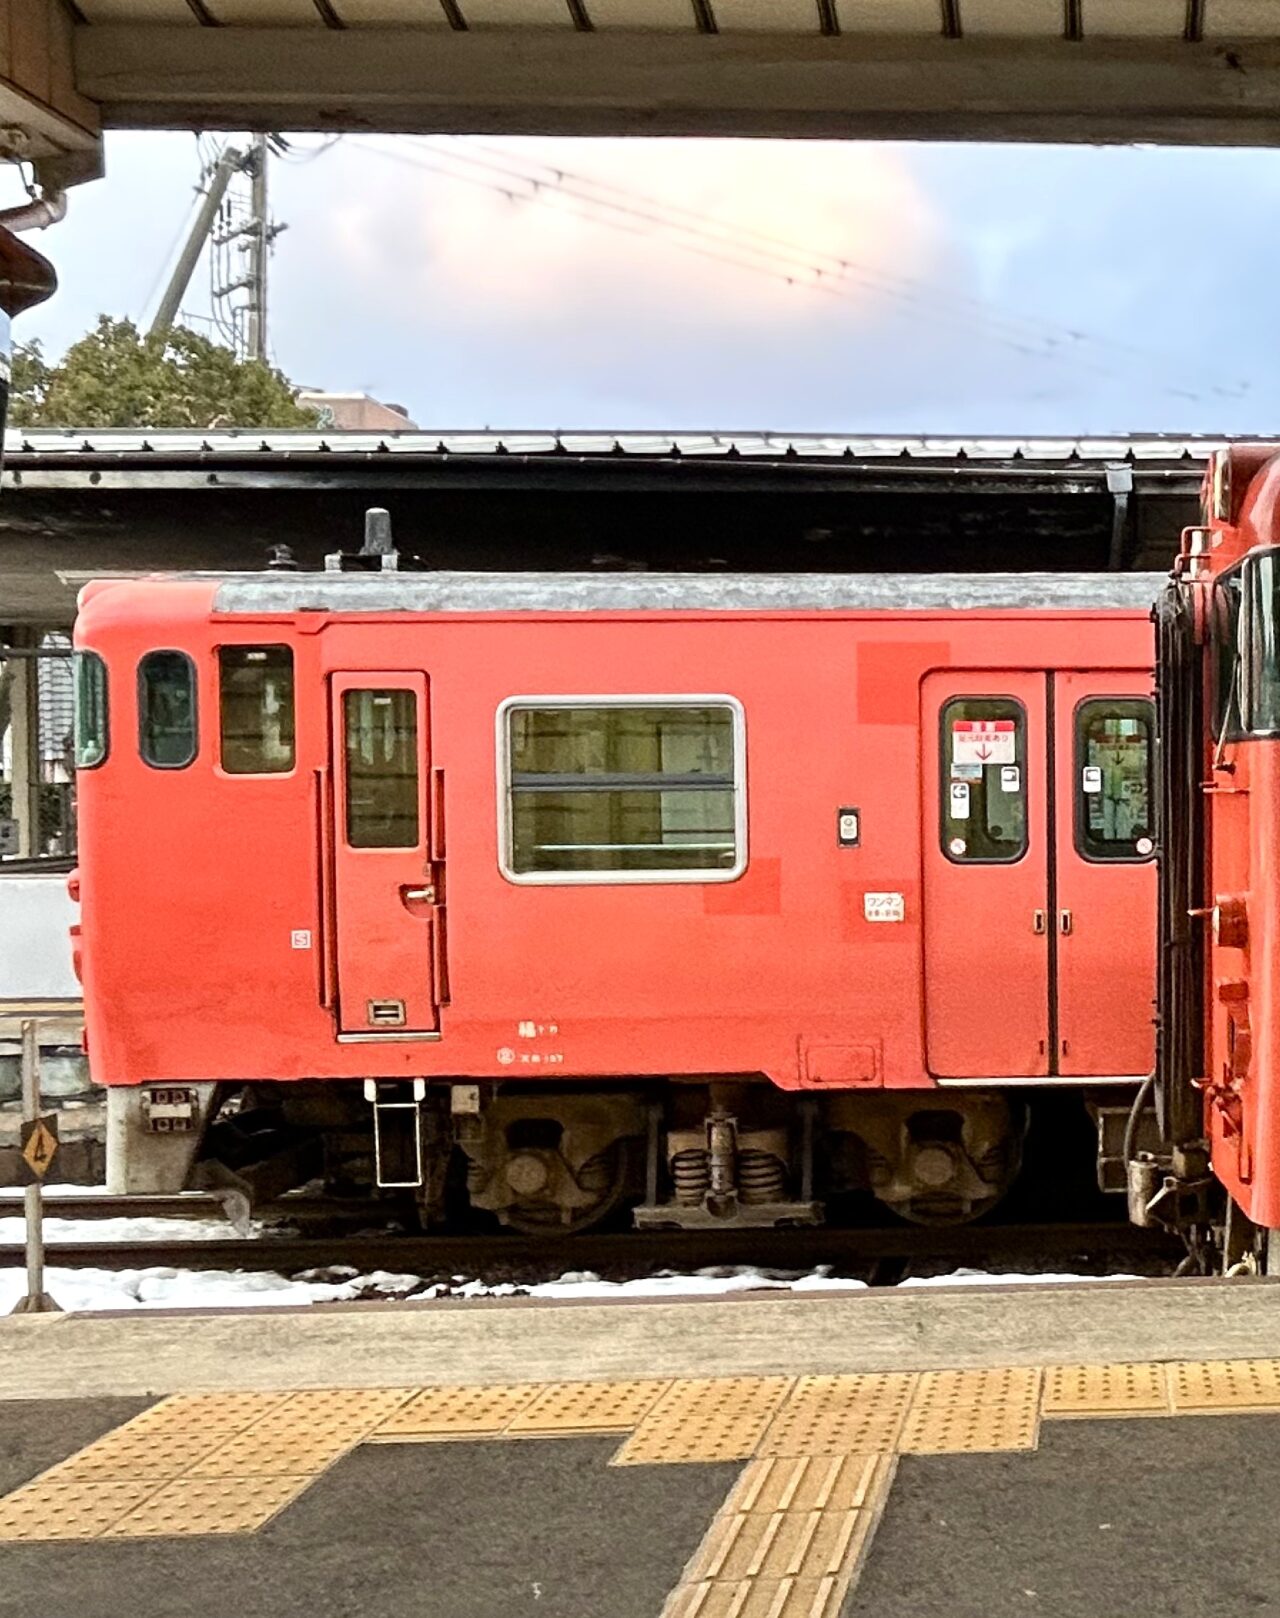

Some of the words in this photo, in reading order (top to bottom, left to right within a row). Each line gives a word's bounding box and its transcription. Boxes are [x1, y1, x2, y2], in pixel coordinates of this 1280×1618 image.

[867, 896, 901, 907] ワンマン
[34, 1132, 48, 1162] 4
